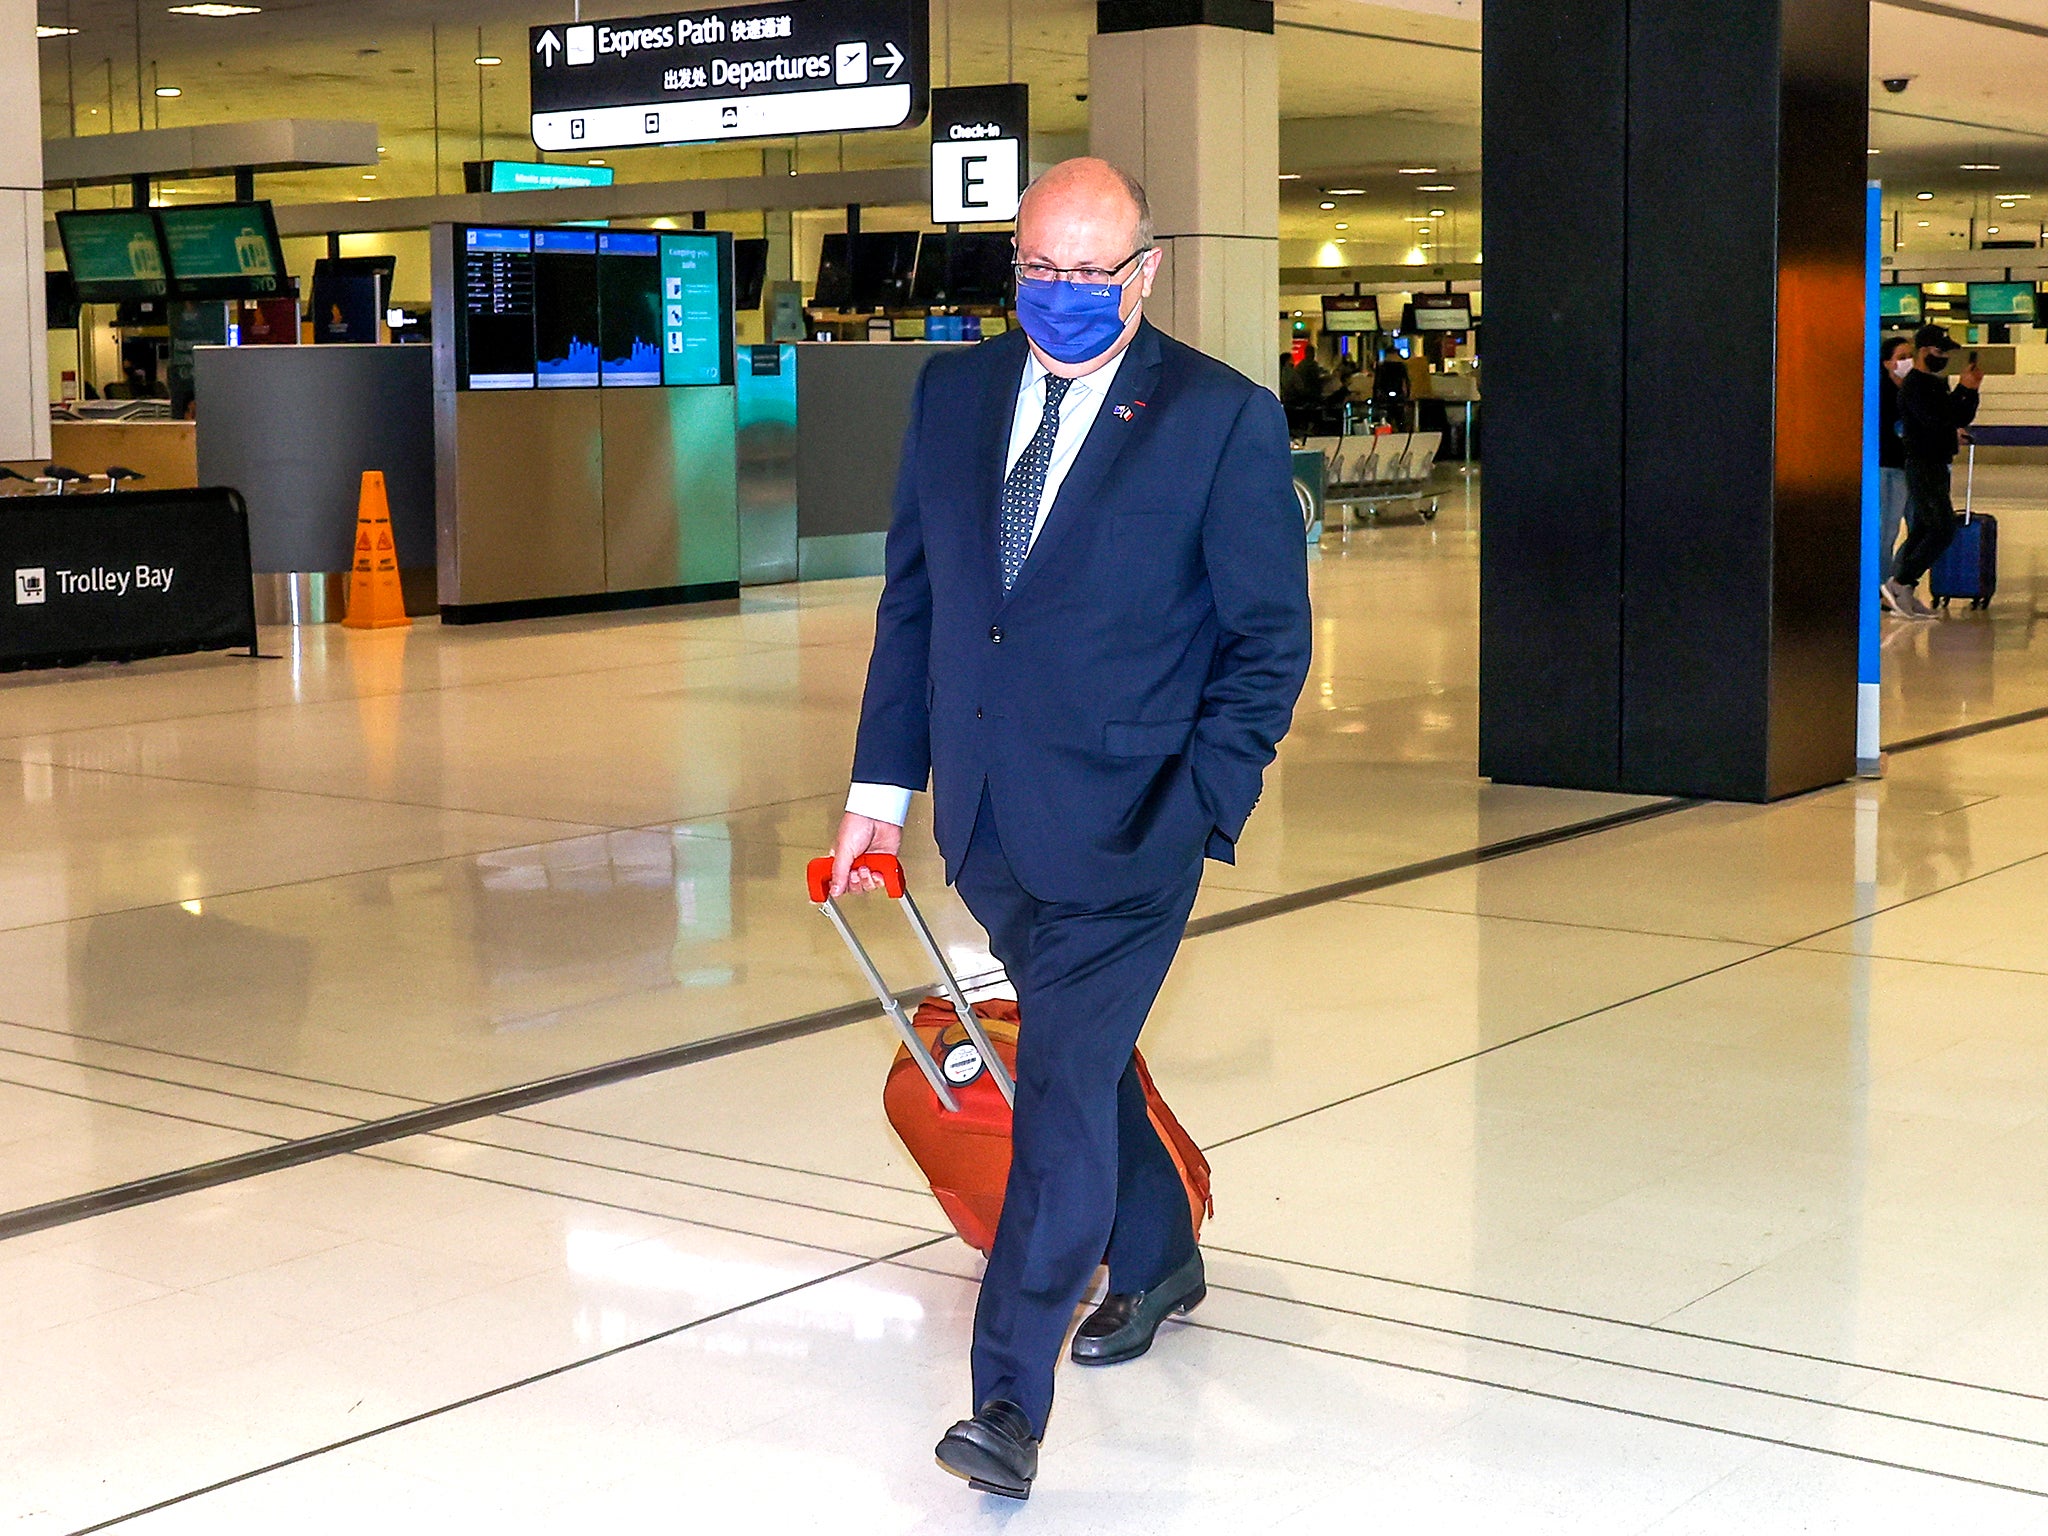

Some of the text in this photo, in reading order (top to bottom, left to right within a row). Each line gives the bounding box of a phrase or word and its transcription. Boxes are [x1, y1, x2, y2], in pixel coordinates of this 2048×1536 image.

[598, 27, 673, 57] Express
[677, 15, 725, 46] Path
[663, 54, 830, 90] 出发处 Departures
[949, 122, 1001, 139] Check-in
[961, 155, 989, 209] E
[56, 565, 174, 596] Trolley Bay
